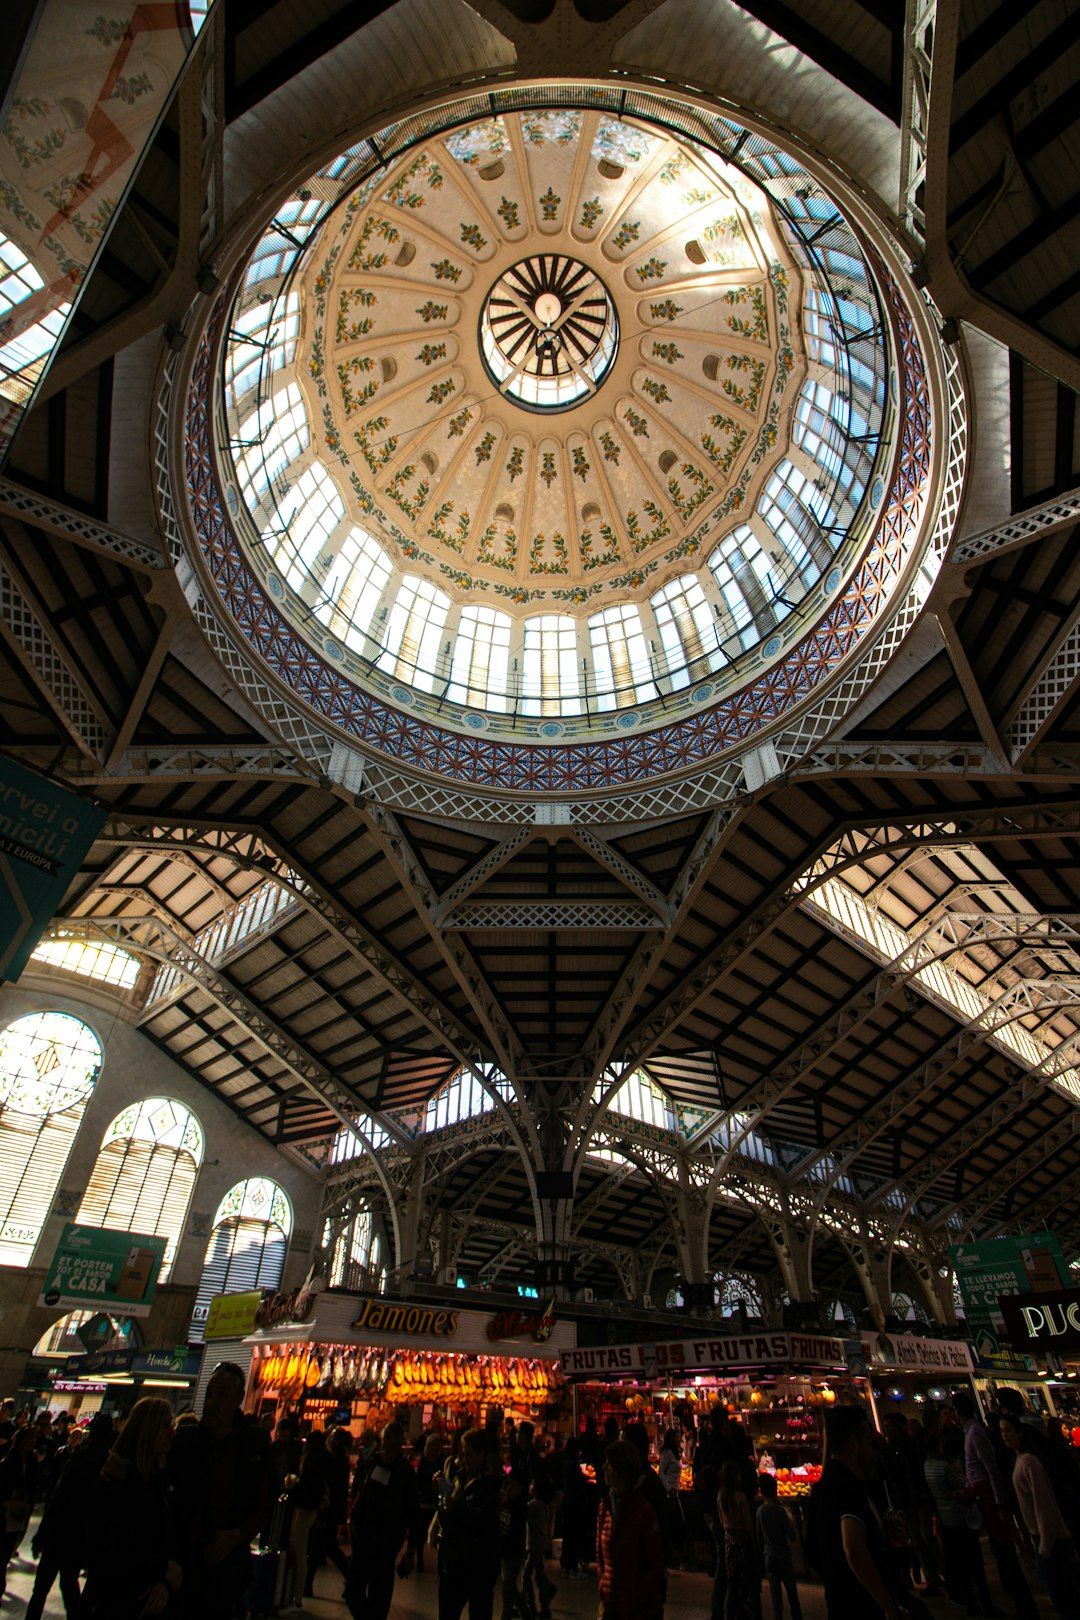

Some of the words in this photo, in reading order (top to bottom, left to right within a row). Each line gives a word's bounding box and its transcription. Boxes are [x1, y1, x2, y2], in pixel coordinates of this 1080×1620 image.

[63, 815, 80, 834] a
[14, 846, 52, 871] EUROPA
[74, 1258, 114, 1272] PORTEM
[50, 1274, 62, 1288] A
[68, 1276, 107, 1293] CASA
[963, 1276, 974, 1285] TE
[975, 1271, 1016, 1284] LLEVAMOS
[986, 1283, 995, 1291] EL
[995, 1280, 1019, 1289] SABOR
[970, 1292, 979, 1305] A
[353, 1297, 459, 1336] Jamones
[561, 1348, 632, 1370] FRUTAS
[638, 1344, 685, 1365] OS
[693, 1336, 788, 1362] FRUTAS
[790, 1336, 841, 1360] FRUTAS
